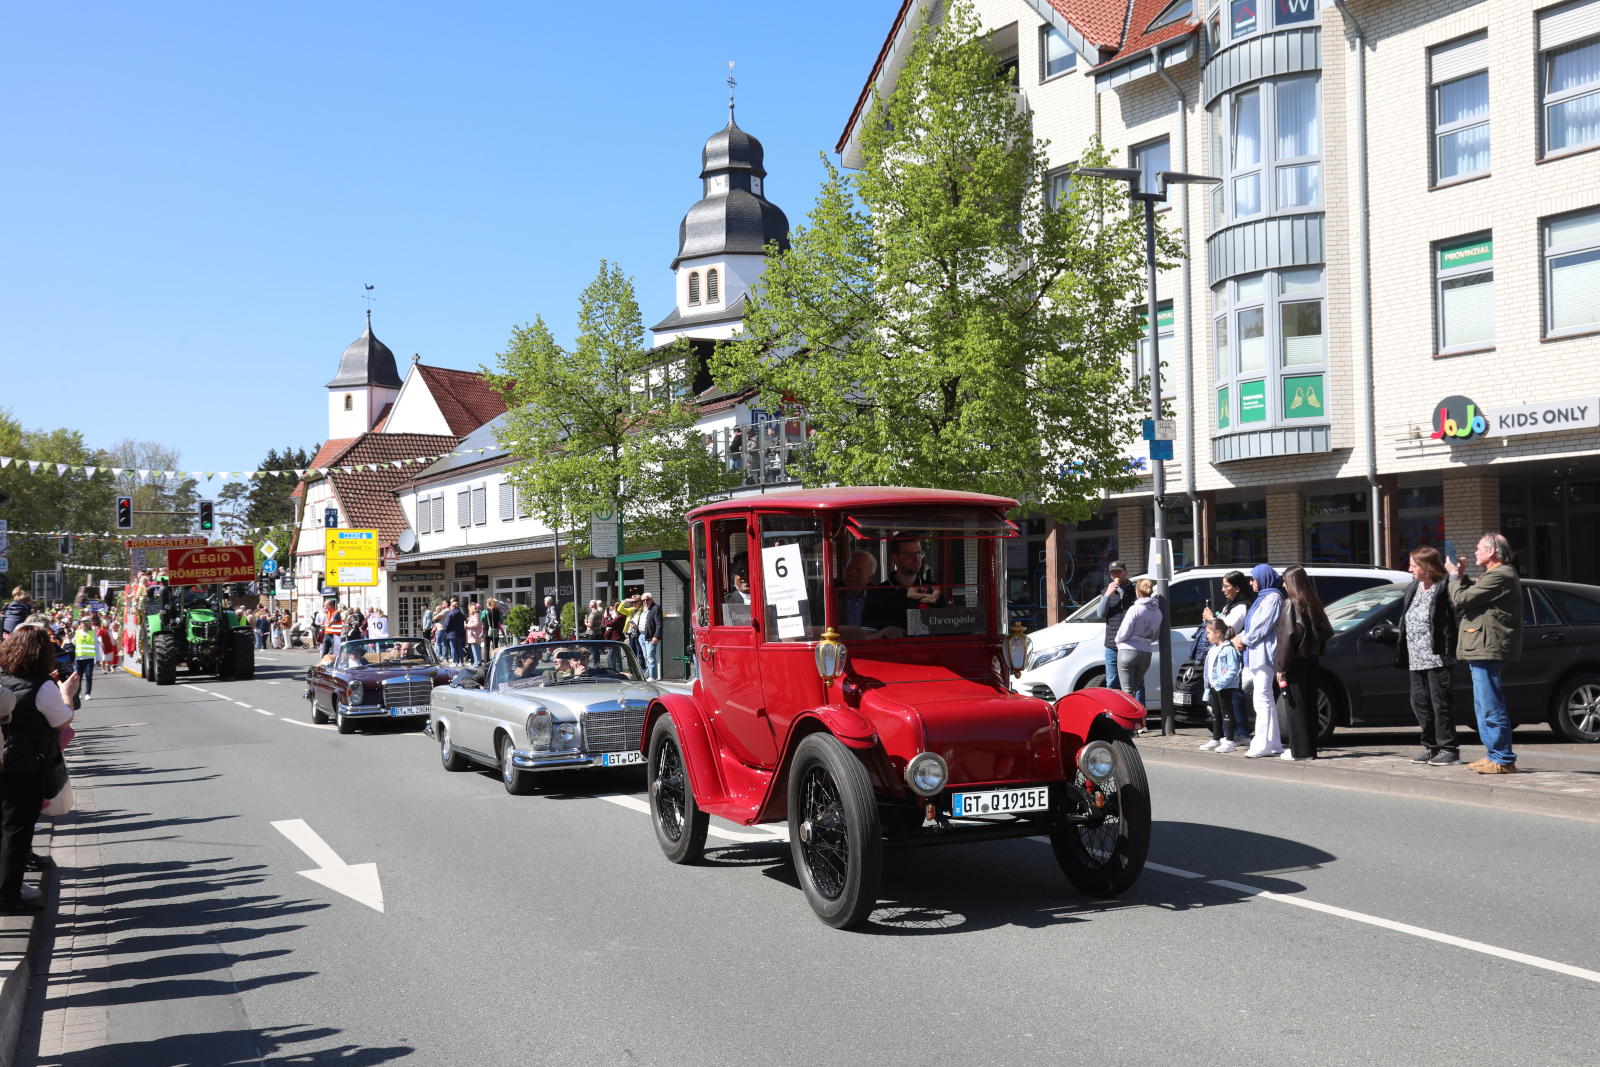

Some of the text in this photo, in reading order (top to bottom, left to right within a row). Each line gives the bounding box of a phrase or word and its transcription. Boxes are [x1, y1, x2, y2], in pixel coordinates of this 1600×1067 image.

[1444, 246, 1490, 262] PROVINZIAL
[1430, 404, 1588, 440] JoJo KIDS ONLY
[192, 553, 231, 564] LEGIO
[169, 566, 255, 579] RÖMERSTRAßE
[775, 557, 788, 577] 6
[371, 621, 382, 630] 10
[929, 615, 976, 627] Ehrengäste
[608, 754, 622, 765] GT
[964, 796, 981, 813] GT
